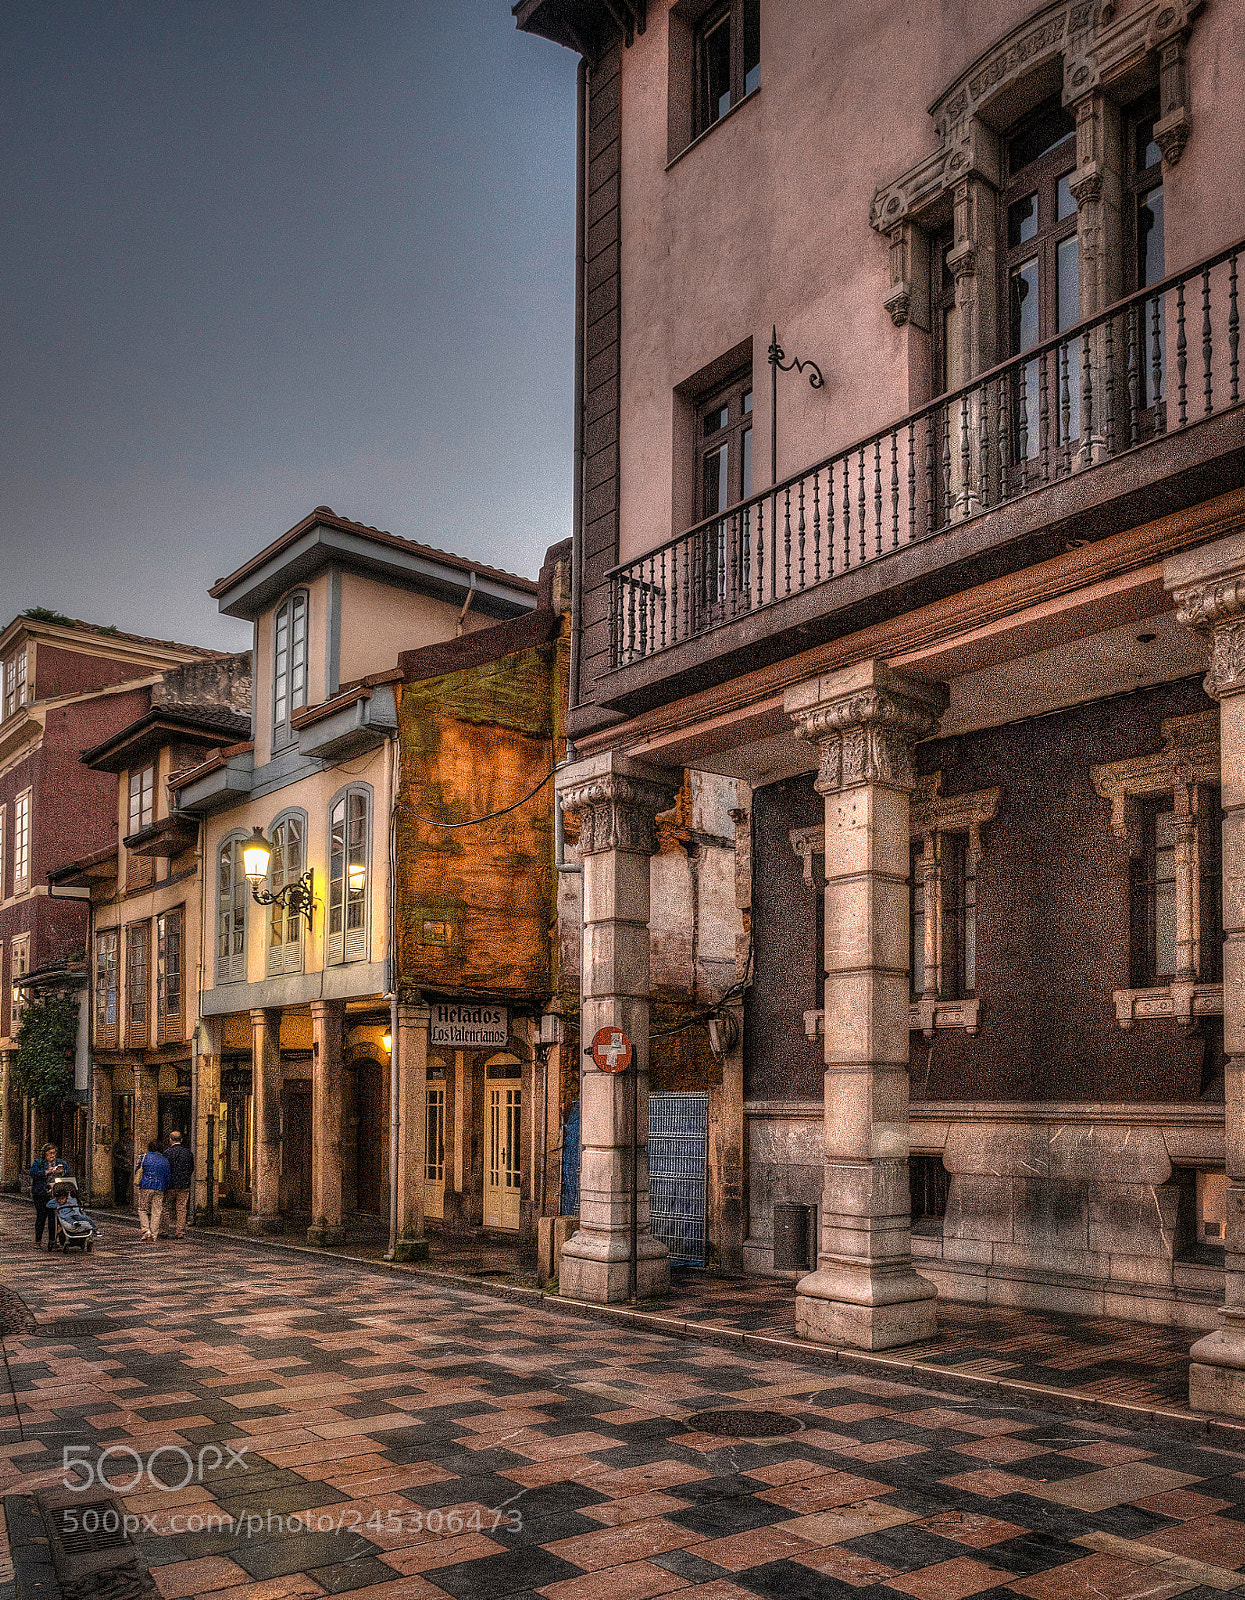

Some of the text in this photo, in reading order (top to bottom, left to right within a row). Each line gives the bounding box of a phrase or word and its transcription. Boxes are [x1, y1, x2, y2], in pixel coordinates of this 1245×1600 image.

[438, 1005, 501, 1024] Helados
[432, 1026, 505, 1043] Los Valencianos
